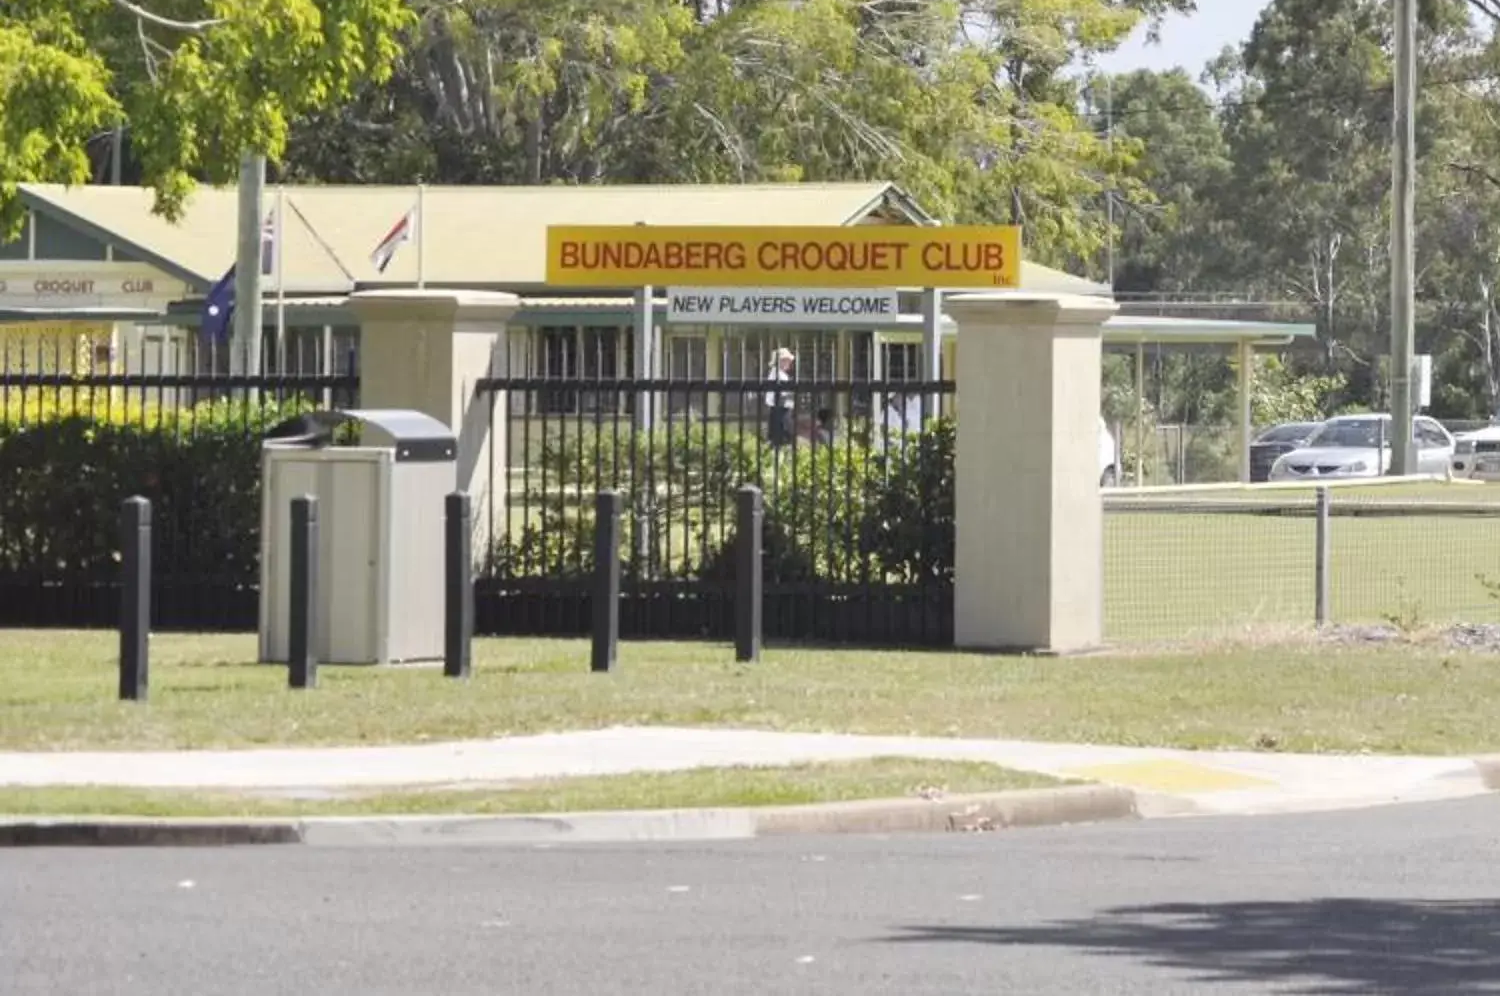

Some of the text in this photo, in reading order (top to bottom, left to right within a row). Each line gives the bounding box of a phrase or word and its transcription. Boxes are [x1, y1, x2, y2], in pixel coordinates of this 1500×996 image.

[560, 241, 1004, 272] BUNDABERG CROQUET CLUB
[34, 280, 153, 294] CROQUET CLUB
[672, 295, 891, 315] NEW PLAYERS WELCOME
